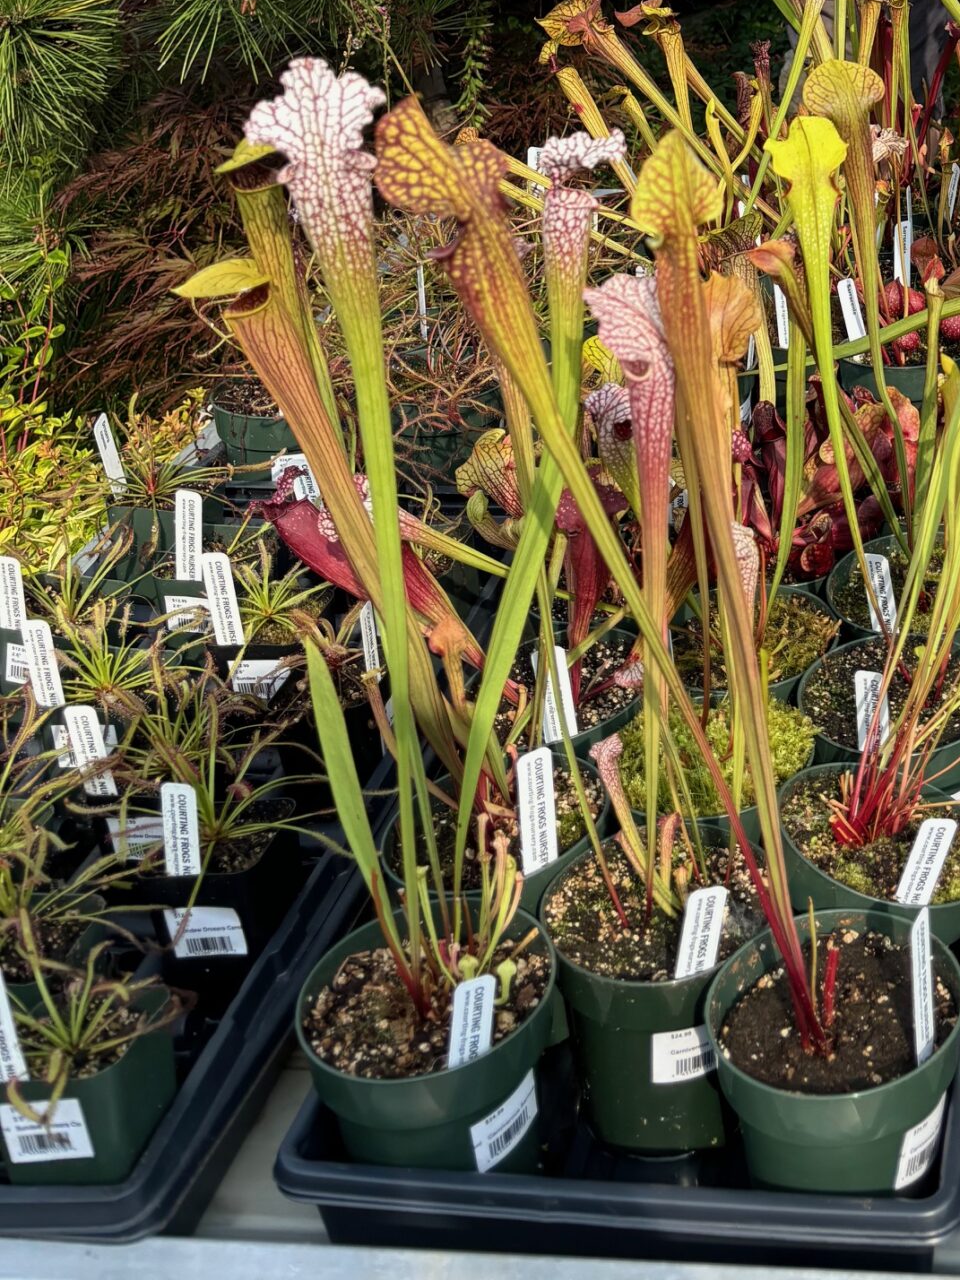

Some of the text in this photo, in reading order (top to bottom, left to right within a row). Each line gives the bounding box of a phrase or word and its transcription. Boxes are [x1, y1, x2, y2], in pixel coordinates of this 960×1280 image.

[8, 564, 20, 617] COURTING FROGS
[215, 561, 228, 595] COURTING
[222, 597, 232, 619] FROGS
[875, 561, 890, 616] COURTING FROGS
[35, 629, 54, 691] COURTING FROGS
[80, 715, 97, 754] COURTING
[177, 794, 188, 835] COURTING
[534, 758, 548, 864] COURTING FROGS NURSER
[180, 837, 190, 863] FROGS
[925, 826, 946, 866] COURTING
[915, 866, 931, 893] FROGS
[701, 895, 716, 934] COURTING
[696, 934, 709, 958] FROGS
[469, 987, 485, 1060] COURTING FROG
